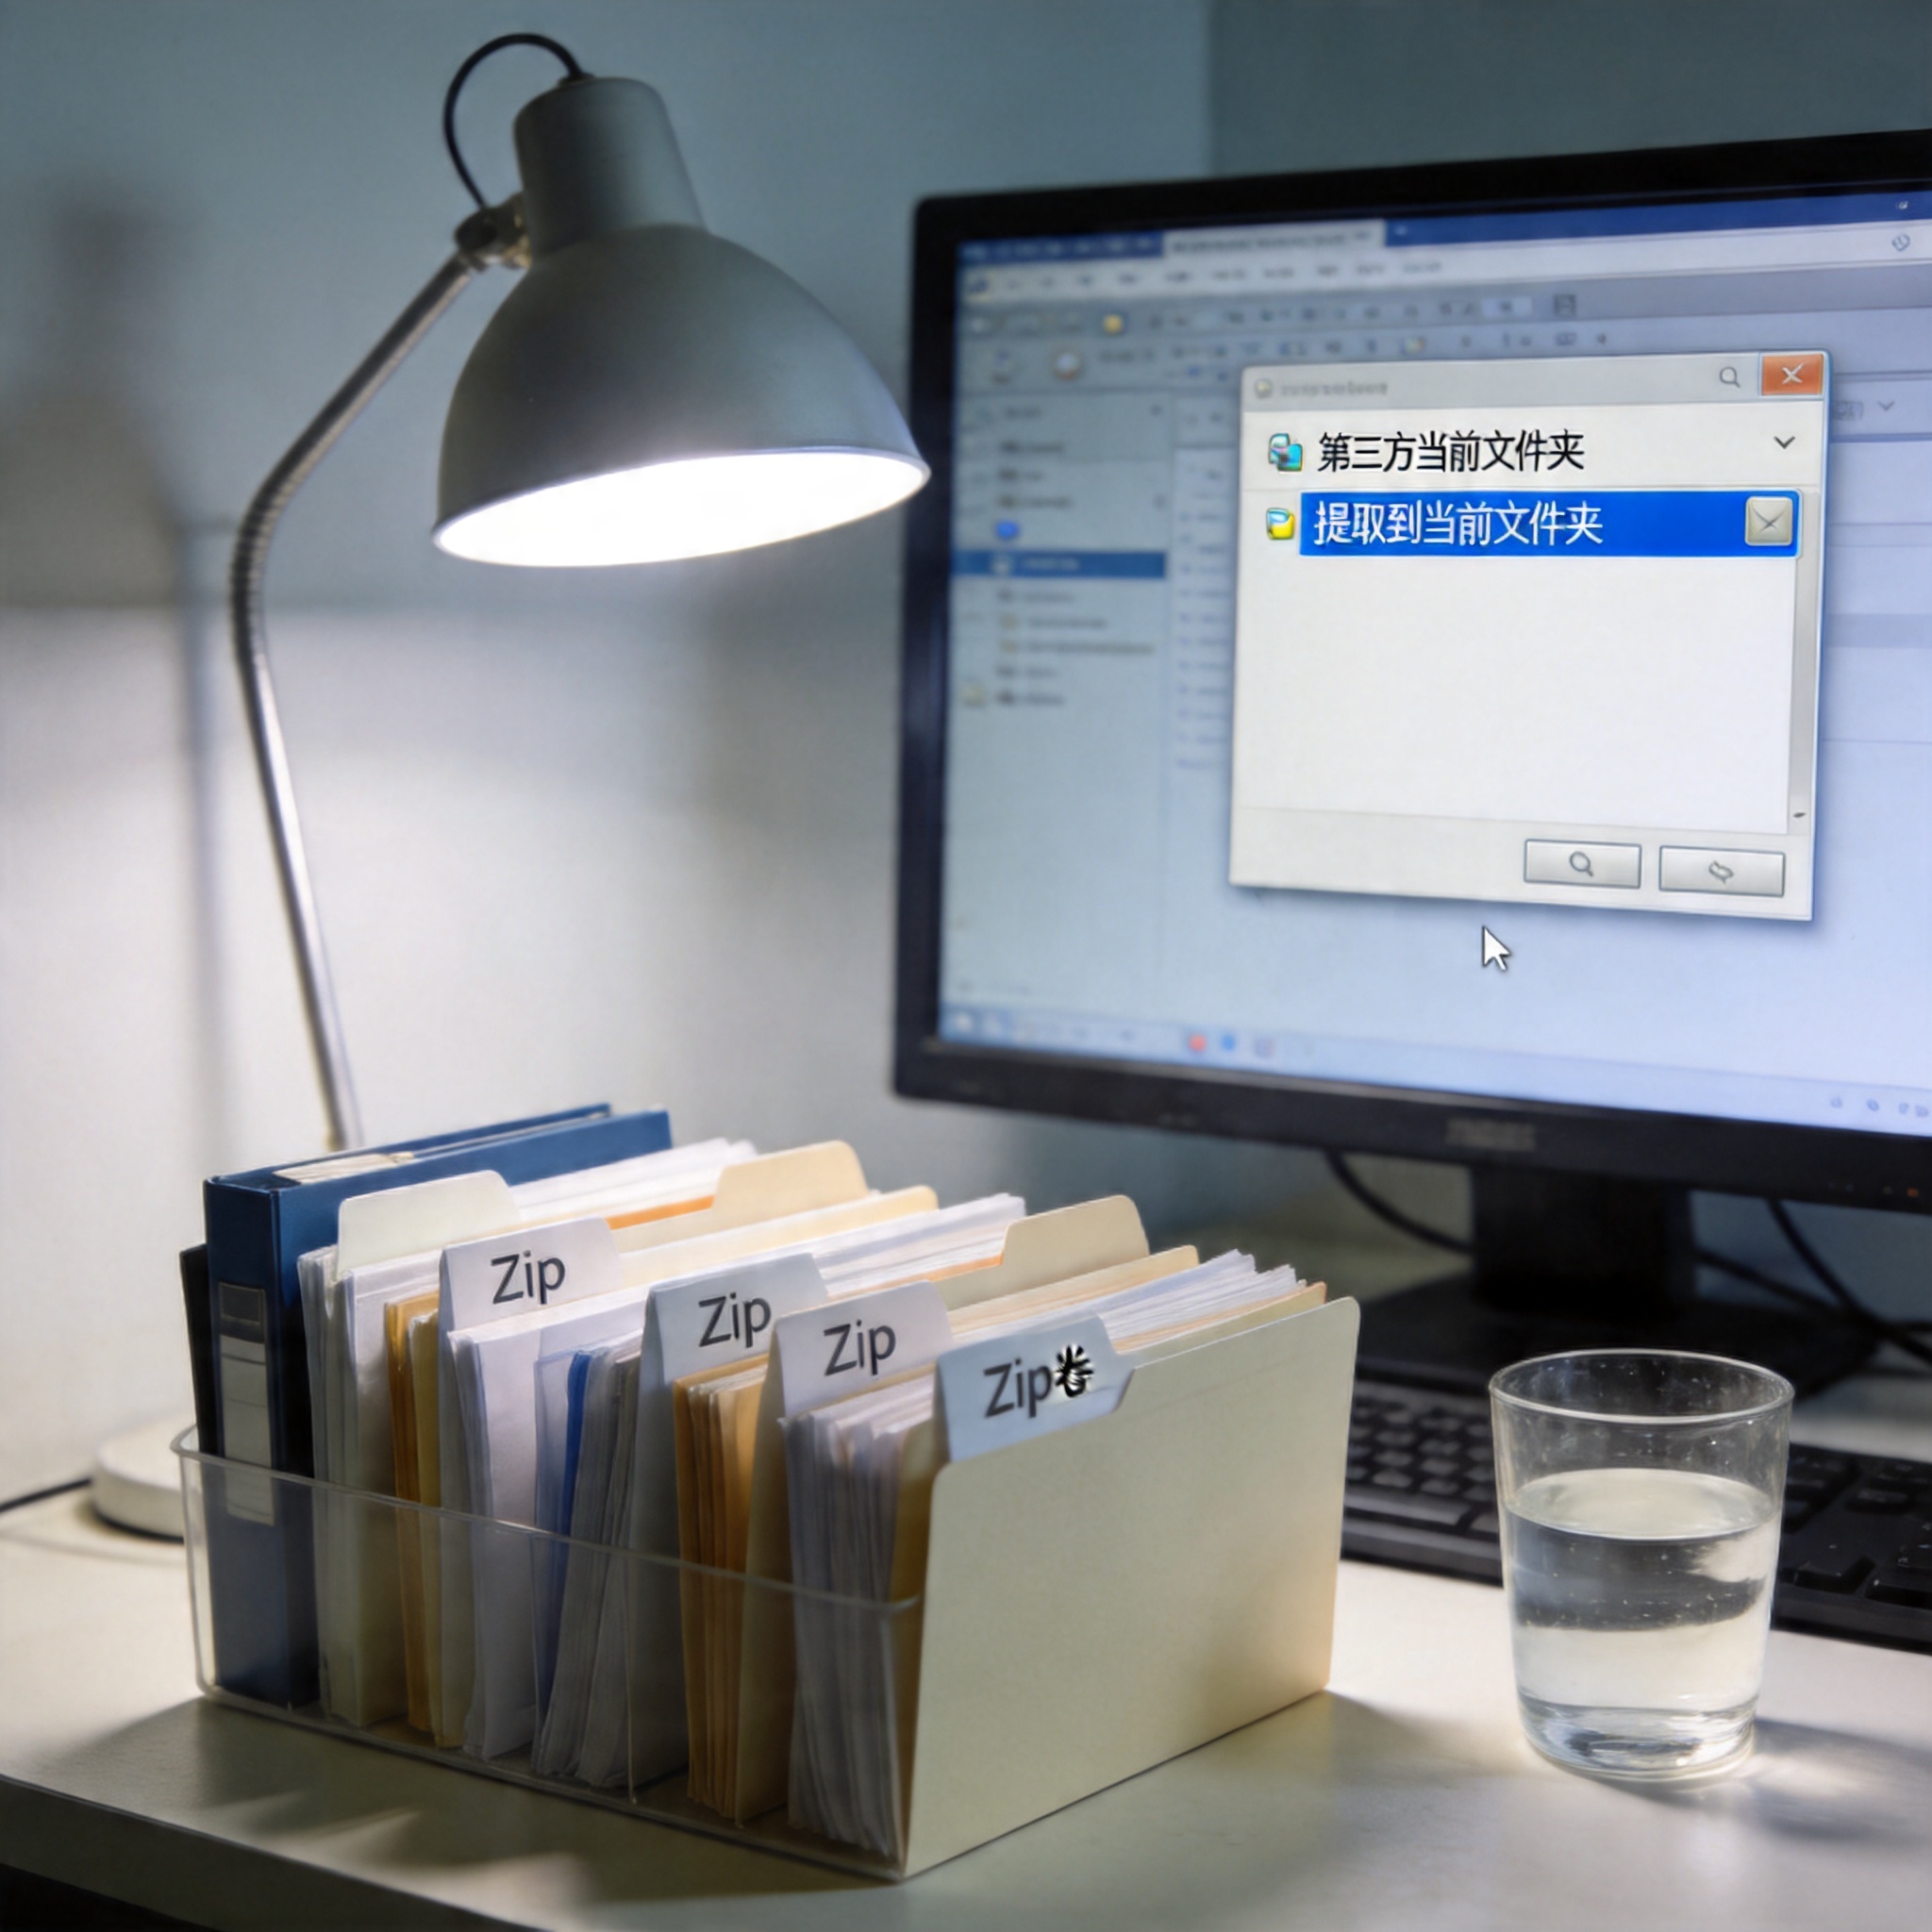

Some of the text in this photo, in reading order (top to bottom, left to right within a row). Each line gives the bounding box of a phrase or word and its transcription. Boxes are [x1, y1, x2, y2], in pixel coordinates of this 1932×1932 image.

[1317, 428, 1586, 473] 第三方当前文件夹
[1313, 499, 1604, 546] 提取到当前文件夹
[491, 1250, 566, 1305] Zip
[698, 1292, 773, 1348] Zip
[823, 1320, 896, 1375] Zip
